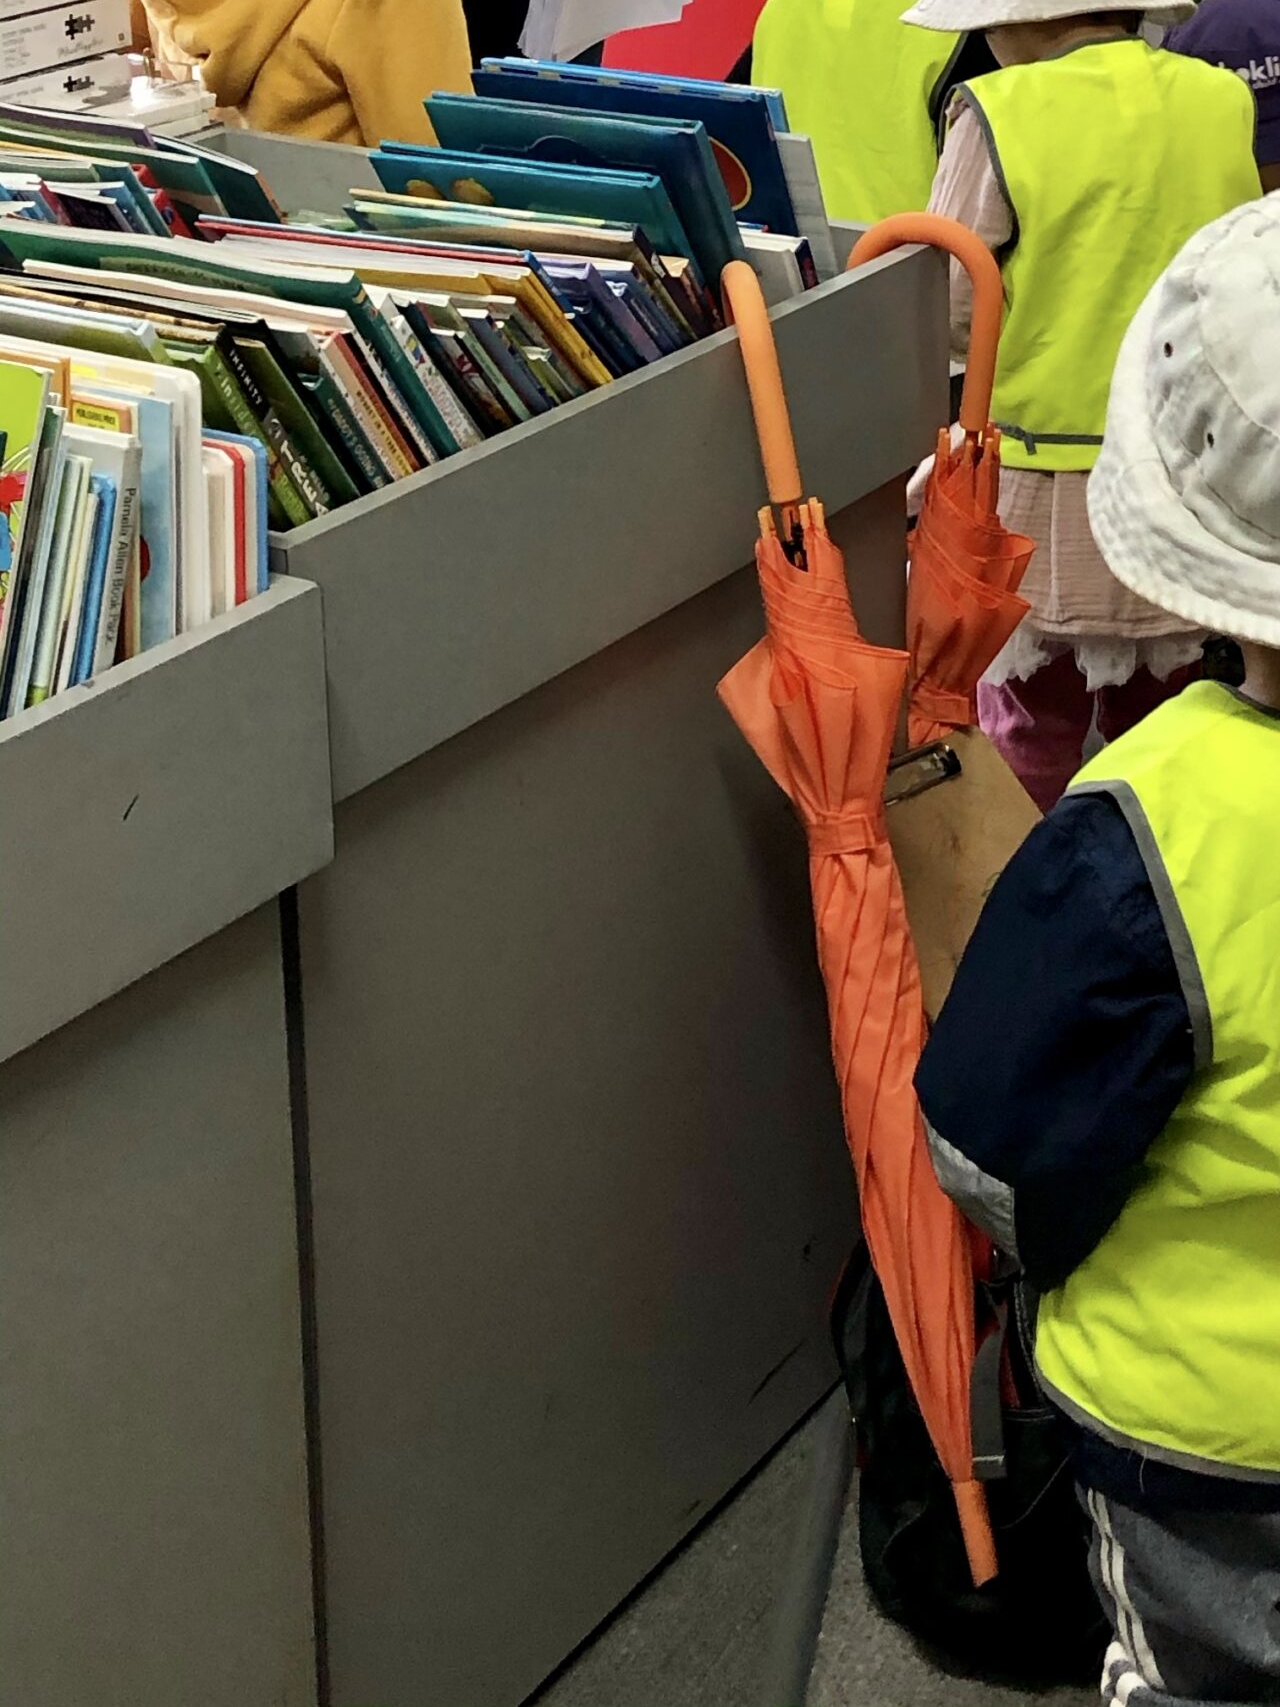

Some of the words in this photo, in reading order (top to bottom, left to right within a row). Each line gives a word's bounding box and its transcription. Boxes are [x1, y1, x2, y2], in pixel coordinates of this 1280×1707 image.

[228, 349, 263, 405] INFINITY
[120, 487, 137, 537] Pamela
[114, 541, 129, 575] Allen
[108, 577, 124, 609] Book
[105, 612, 120, 644] Pack
